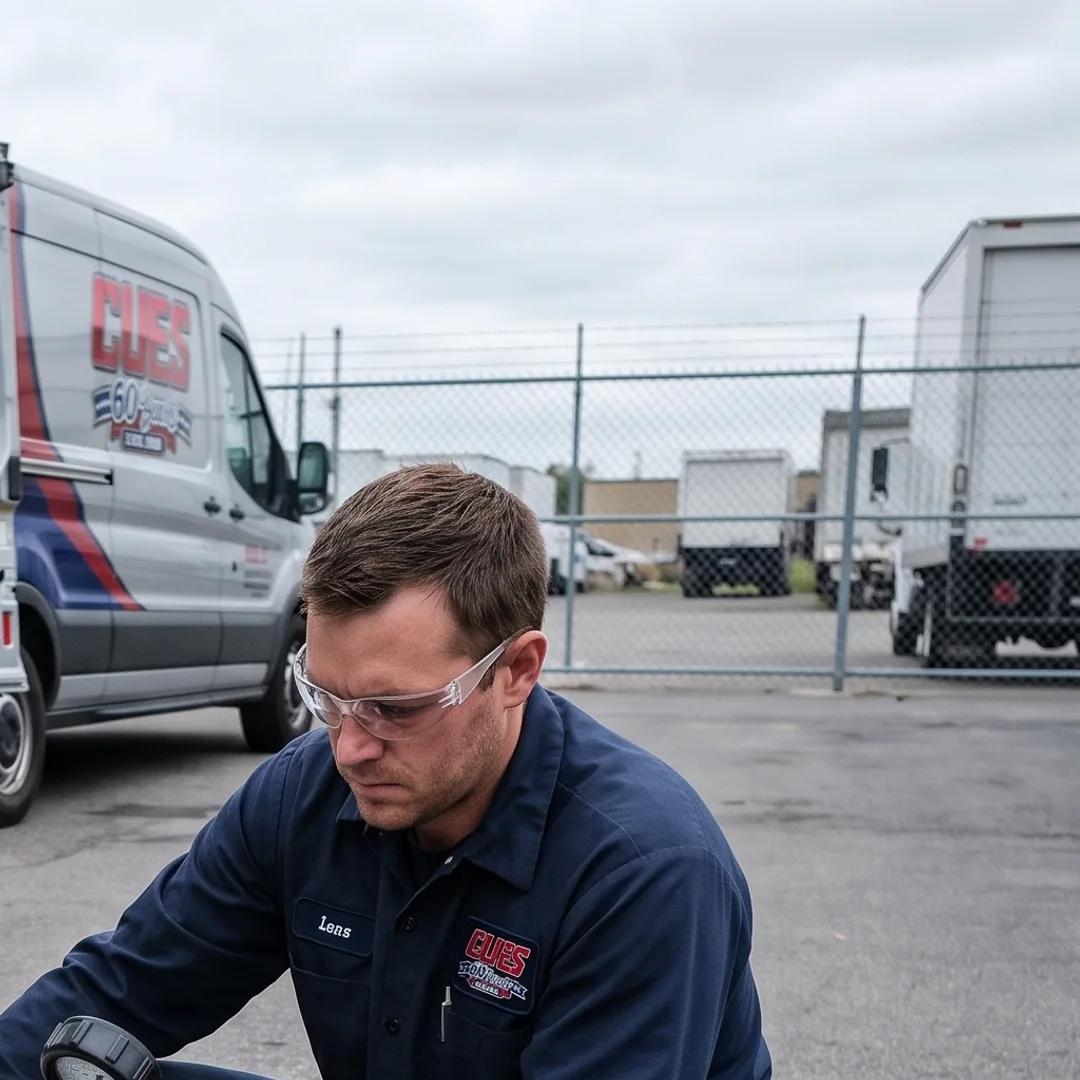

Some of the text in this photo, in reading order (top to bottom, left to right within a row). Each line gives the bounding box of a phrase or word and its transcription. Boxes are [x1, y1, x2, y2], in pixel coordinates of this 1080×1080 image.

[91, 273, 191, 392] CUES
[112, 378, 140, 424] 60
[465, 928, 531, 978] CUES
